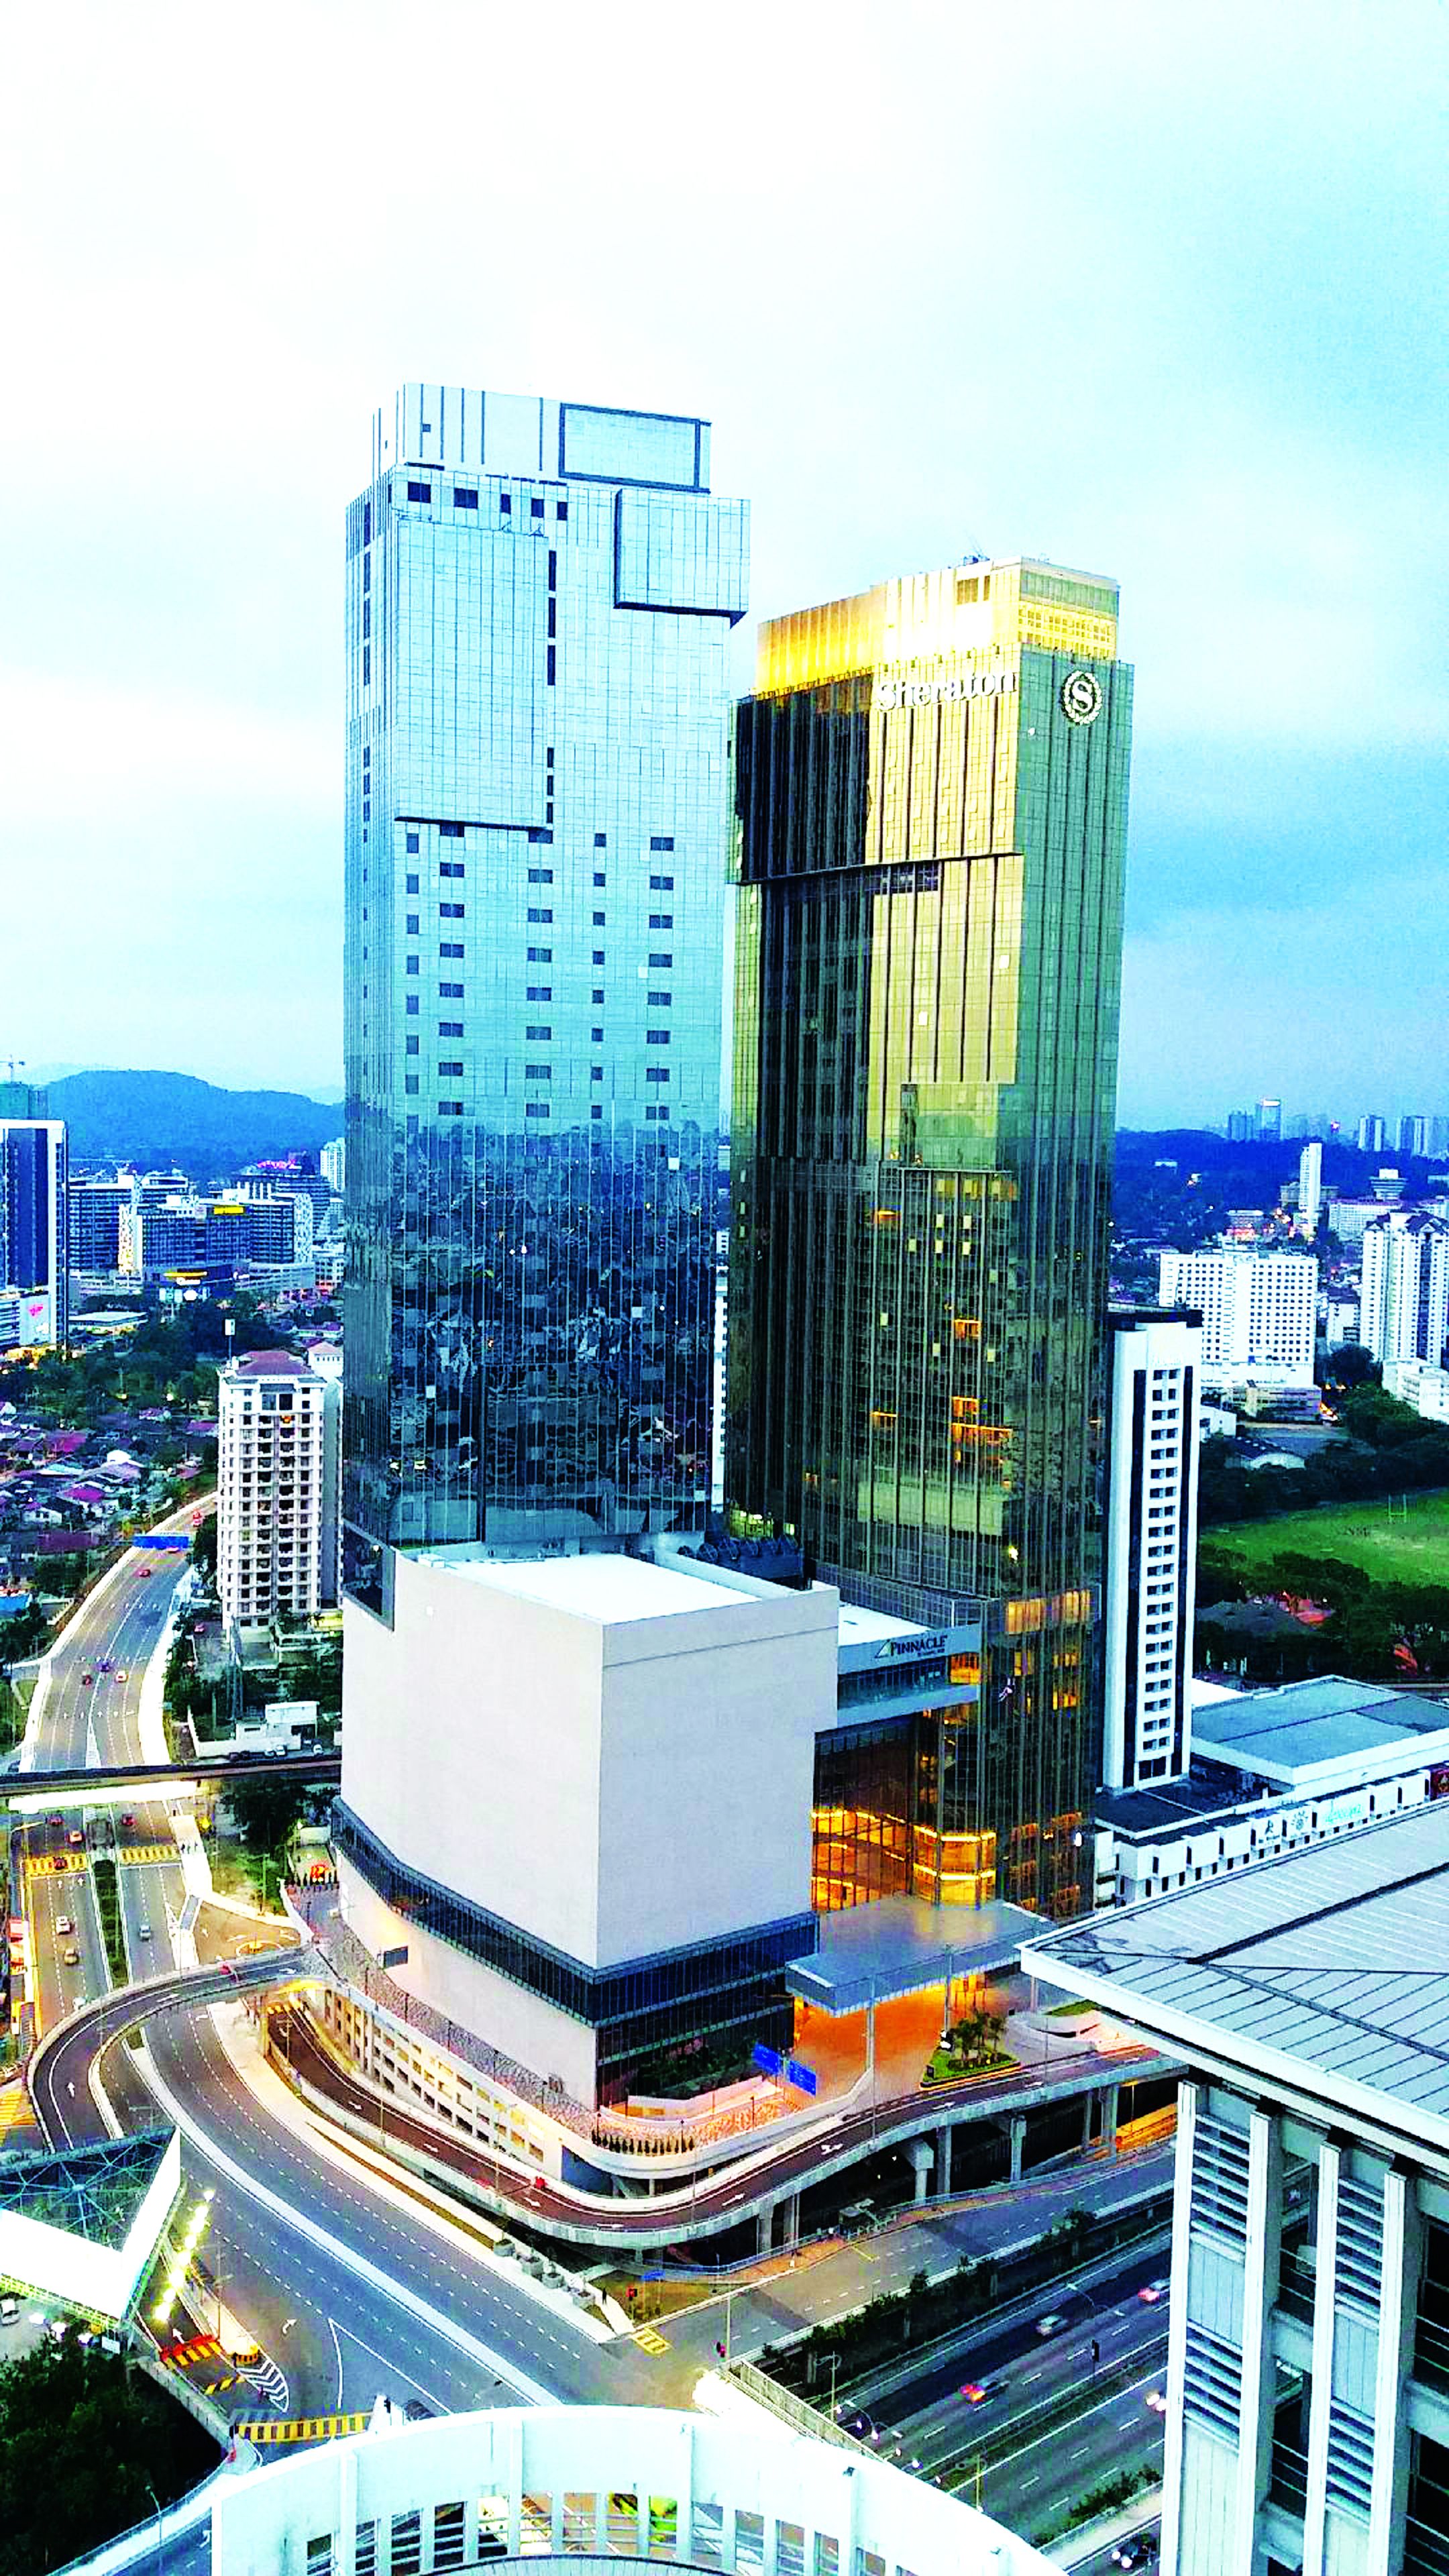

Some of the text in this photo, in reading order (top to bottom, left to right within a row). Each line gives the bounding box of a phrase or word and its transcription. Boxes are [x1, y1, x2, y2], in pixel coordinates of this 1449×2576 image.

[877, 672, 1018, 712] Sheraton
[1071, 680, 1093, 713] S
[890, 1635, 947, 1656] PINNACLE
